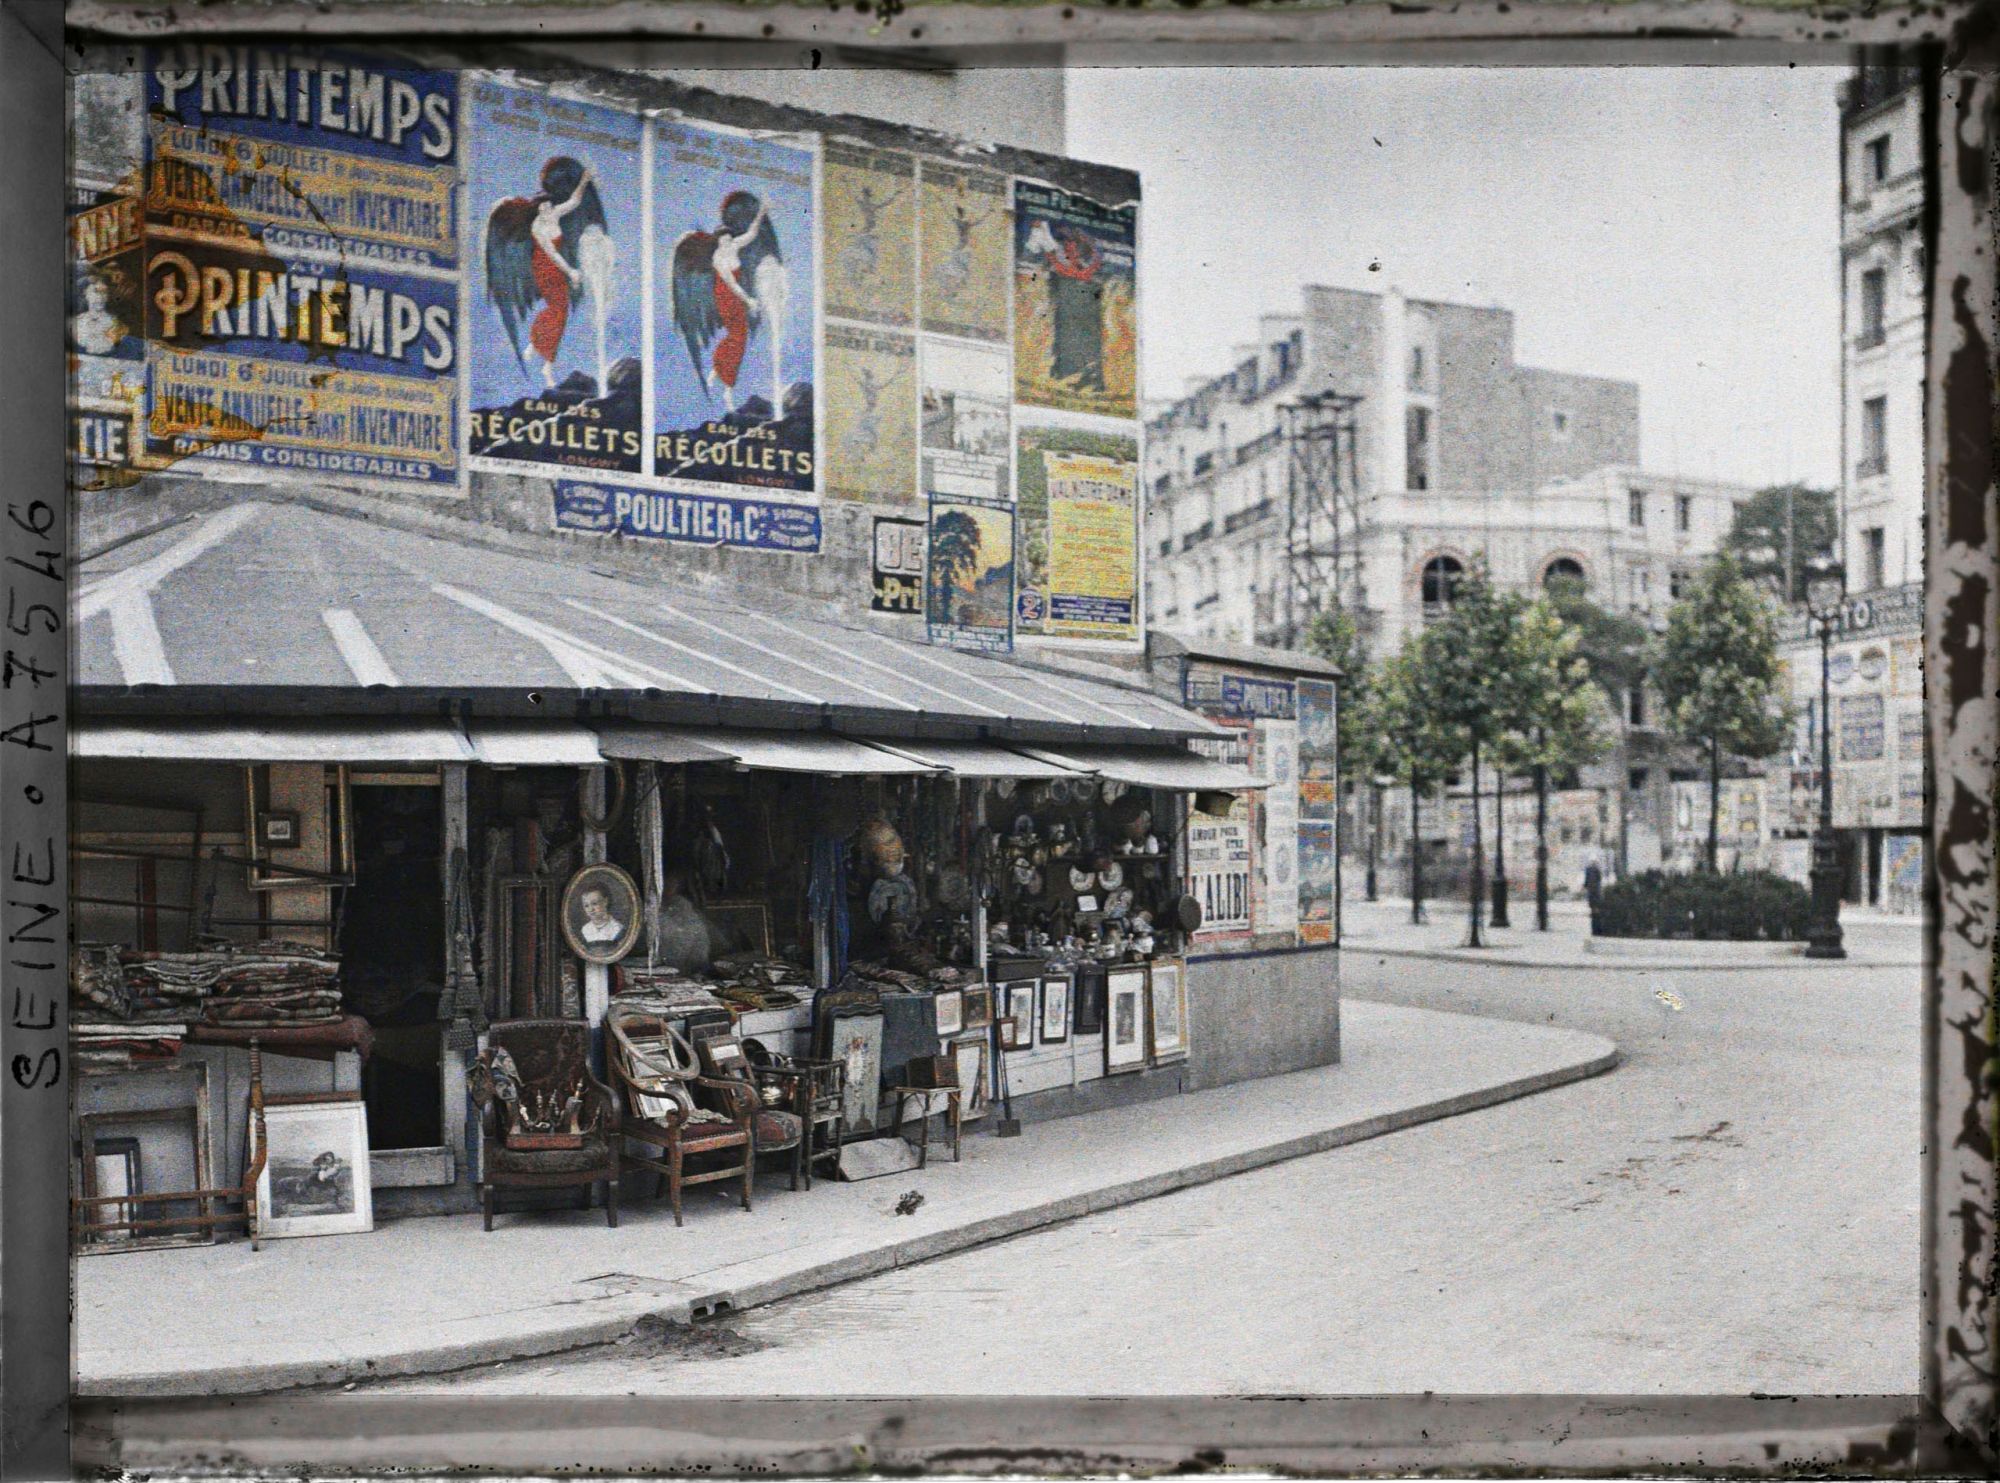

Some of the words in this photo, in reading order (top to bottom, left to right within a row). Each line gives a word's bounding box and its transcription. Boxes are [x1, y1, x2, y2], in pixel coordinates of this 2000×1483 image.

[155, 50, 451, 158] PRINTEMPS
[350, 189, 442, 240] INVENTAIRE
[149, 251, 452, 369] PRINTEMPS
[172, 355, 227, 378] LUNDI
[238, 363, 252, 382] 6
[163, 382, 215, 426] VENTE
[525, 399, 559, 414] EAU
[567, 404, 601, 419] DES
[173, 437, 252, 461] RABAIS
[351, 404, 442, 453] INVENTAIRE
[470, 405, 640, 456] RÉCOLLETS
[707, 422, 738, 437] EAU
[746, 426, 777, 441] DES
[656, 430, 813, 475] RÉCOLLETS
[614, 491, 732, 540] POULTIER
